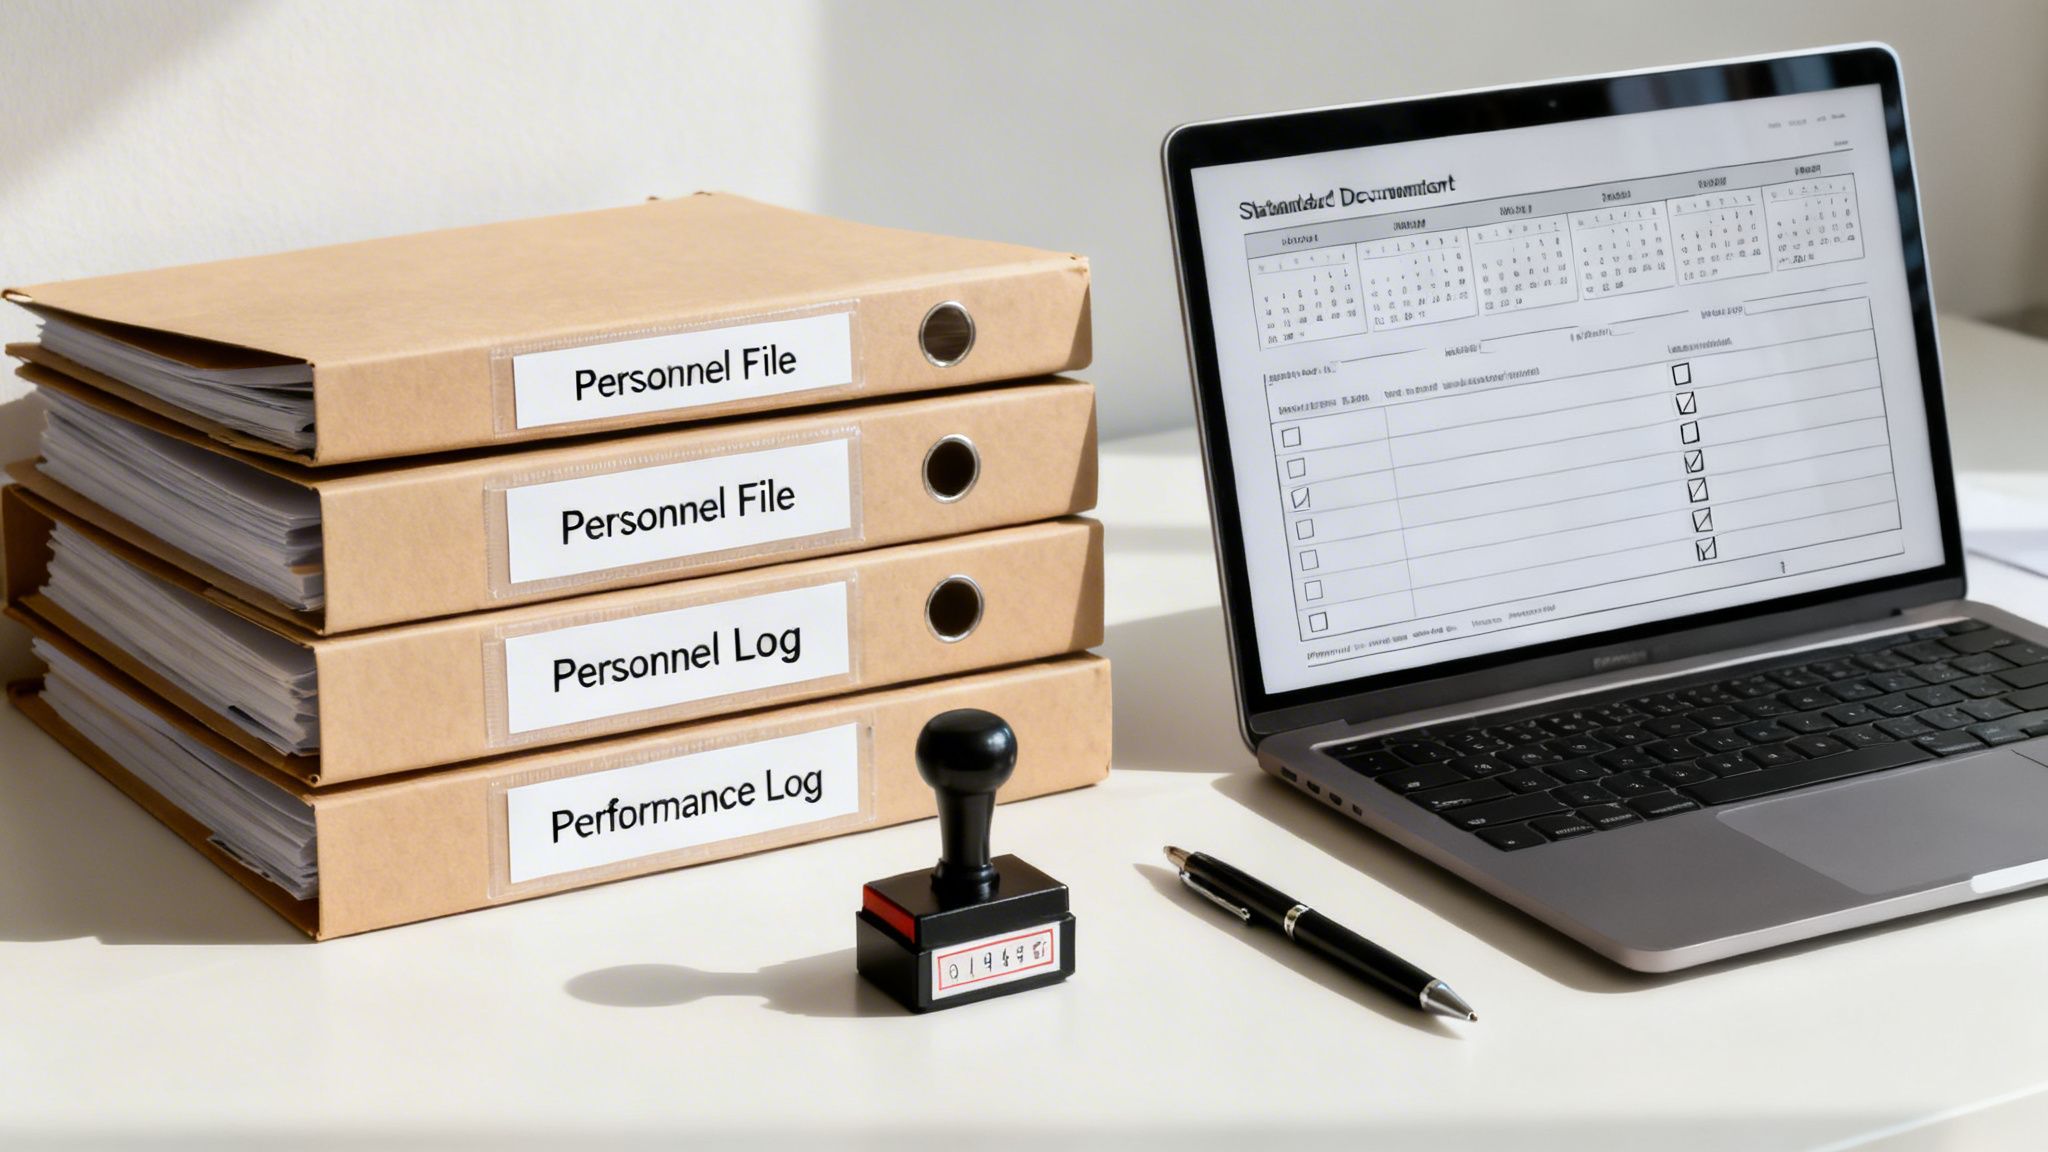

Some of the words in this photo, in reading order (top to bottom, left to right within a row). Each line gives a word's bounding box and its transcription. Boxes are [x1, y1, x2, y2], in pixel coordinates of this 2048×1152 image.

[576, 349, 730, 401] Personnel
[743, 344, 796, 379] File
[562, 486, 726, 545] Personnel
[739, 479, 796, 517] File
[553, 630, 720, 693] Personnel
[735, 627, 801, 663] Log
[552, 781, 756, 843] Performance
[766, 769, 823, 803] Log
